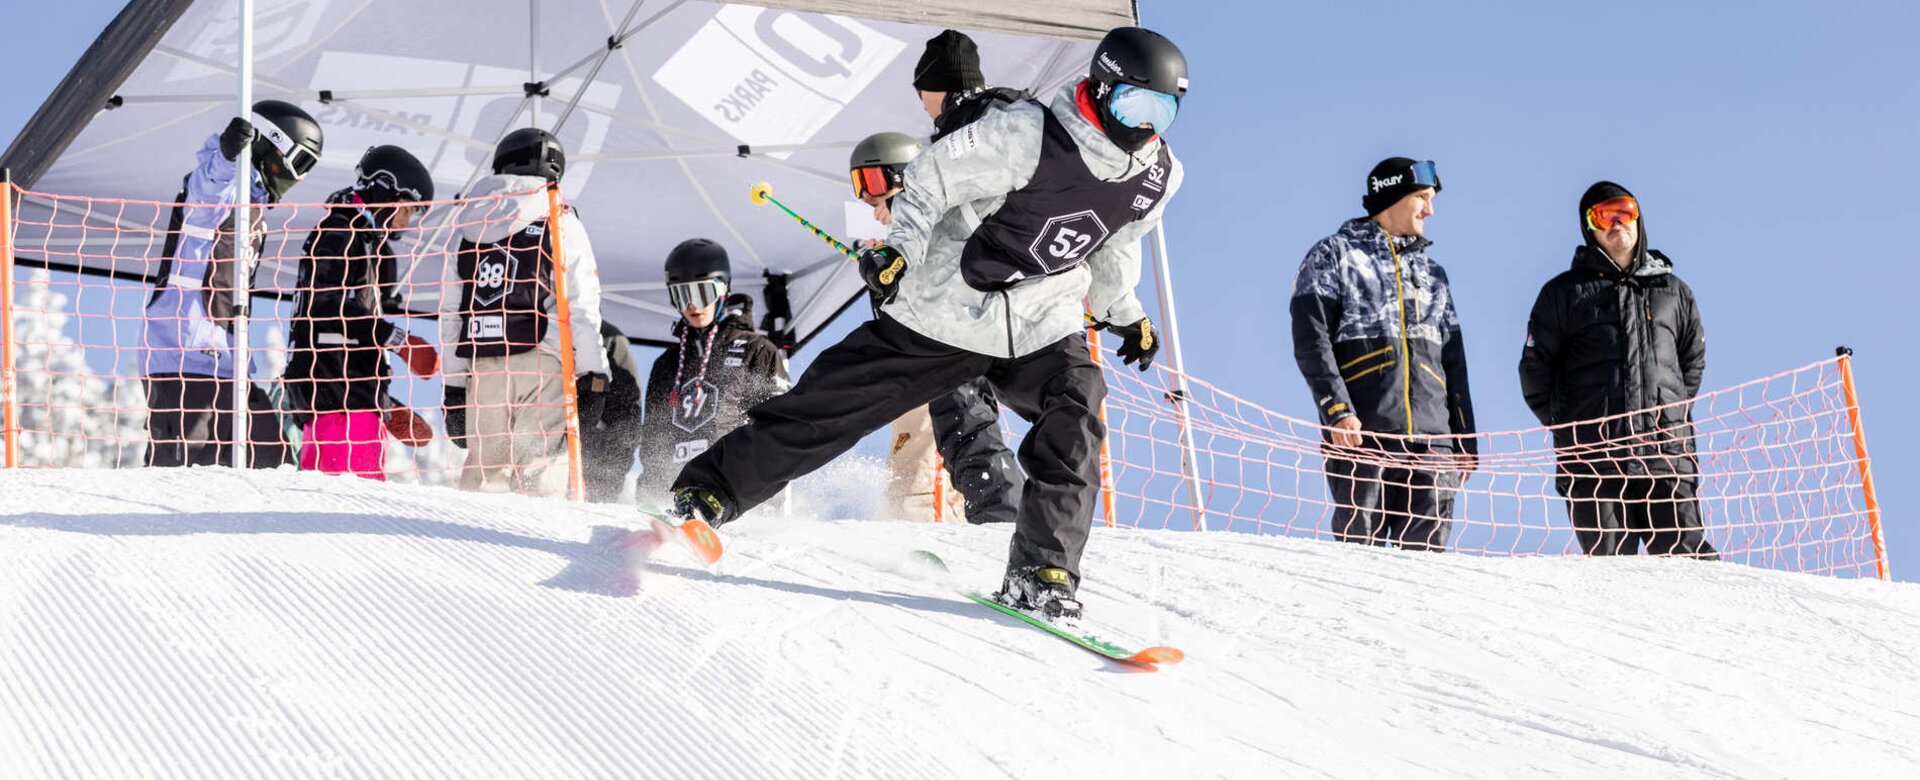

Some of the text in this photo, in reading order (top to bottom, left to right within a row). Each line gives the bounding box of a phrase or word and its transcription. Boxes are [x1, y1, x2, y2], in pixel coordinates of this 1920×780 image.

[1148, 163, 1165, 184] 52
[1049, 227, 1092, 259] 52
[478, 262, 505, 288] 88
